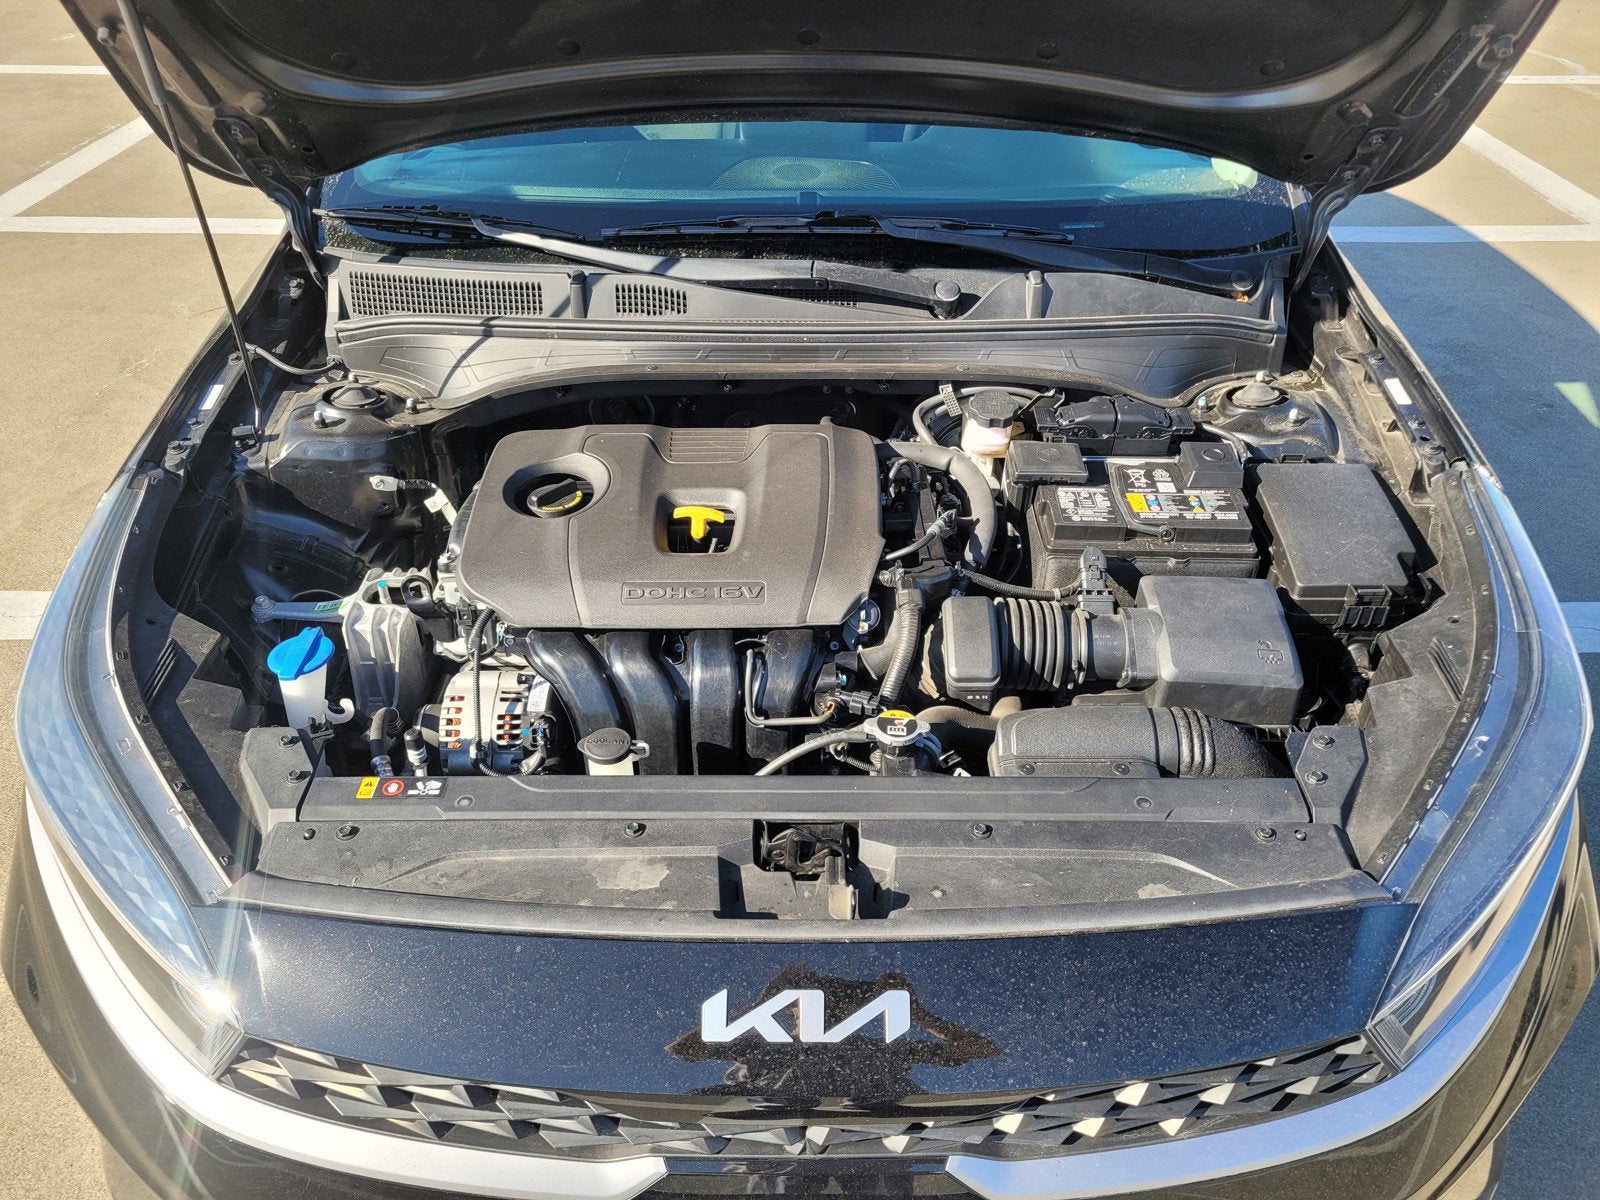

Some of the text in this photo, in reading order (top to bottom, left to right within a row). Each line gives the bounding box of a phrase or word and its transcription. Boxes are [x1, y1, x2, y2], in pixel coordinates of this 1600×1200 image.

[625, 585, 764, 600] DOHC 16V
[702, 988, 911, 1044] KIA
